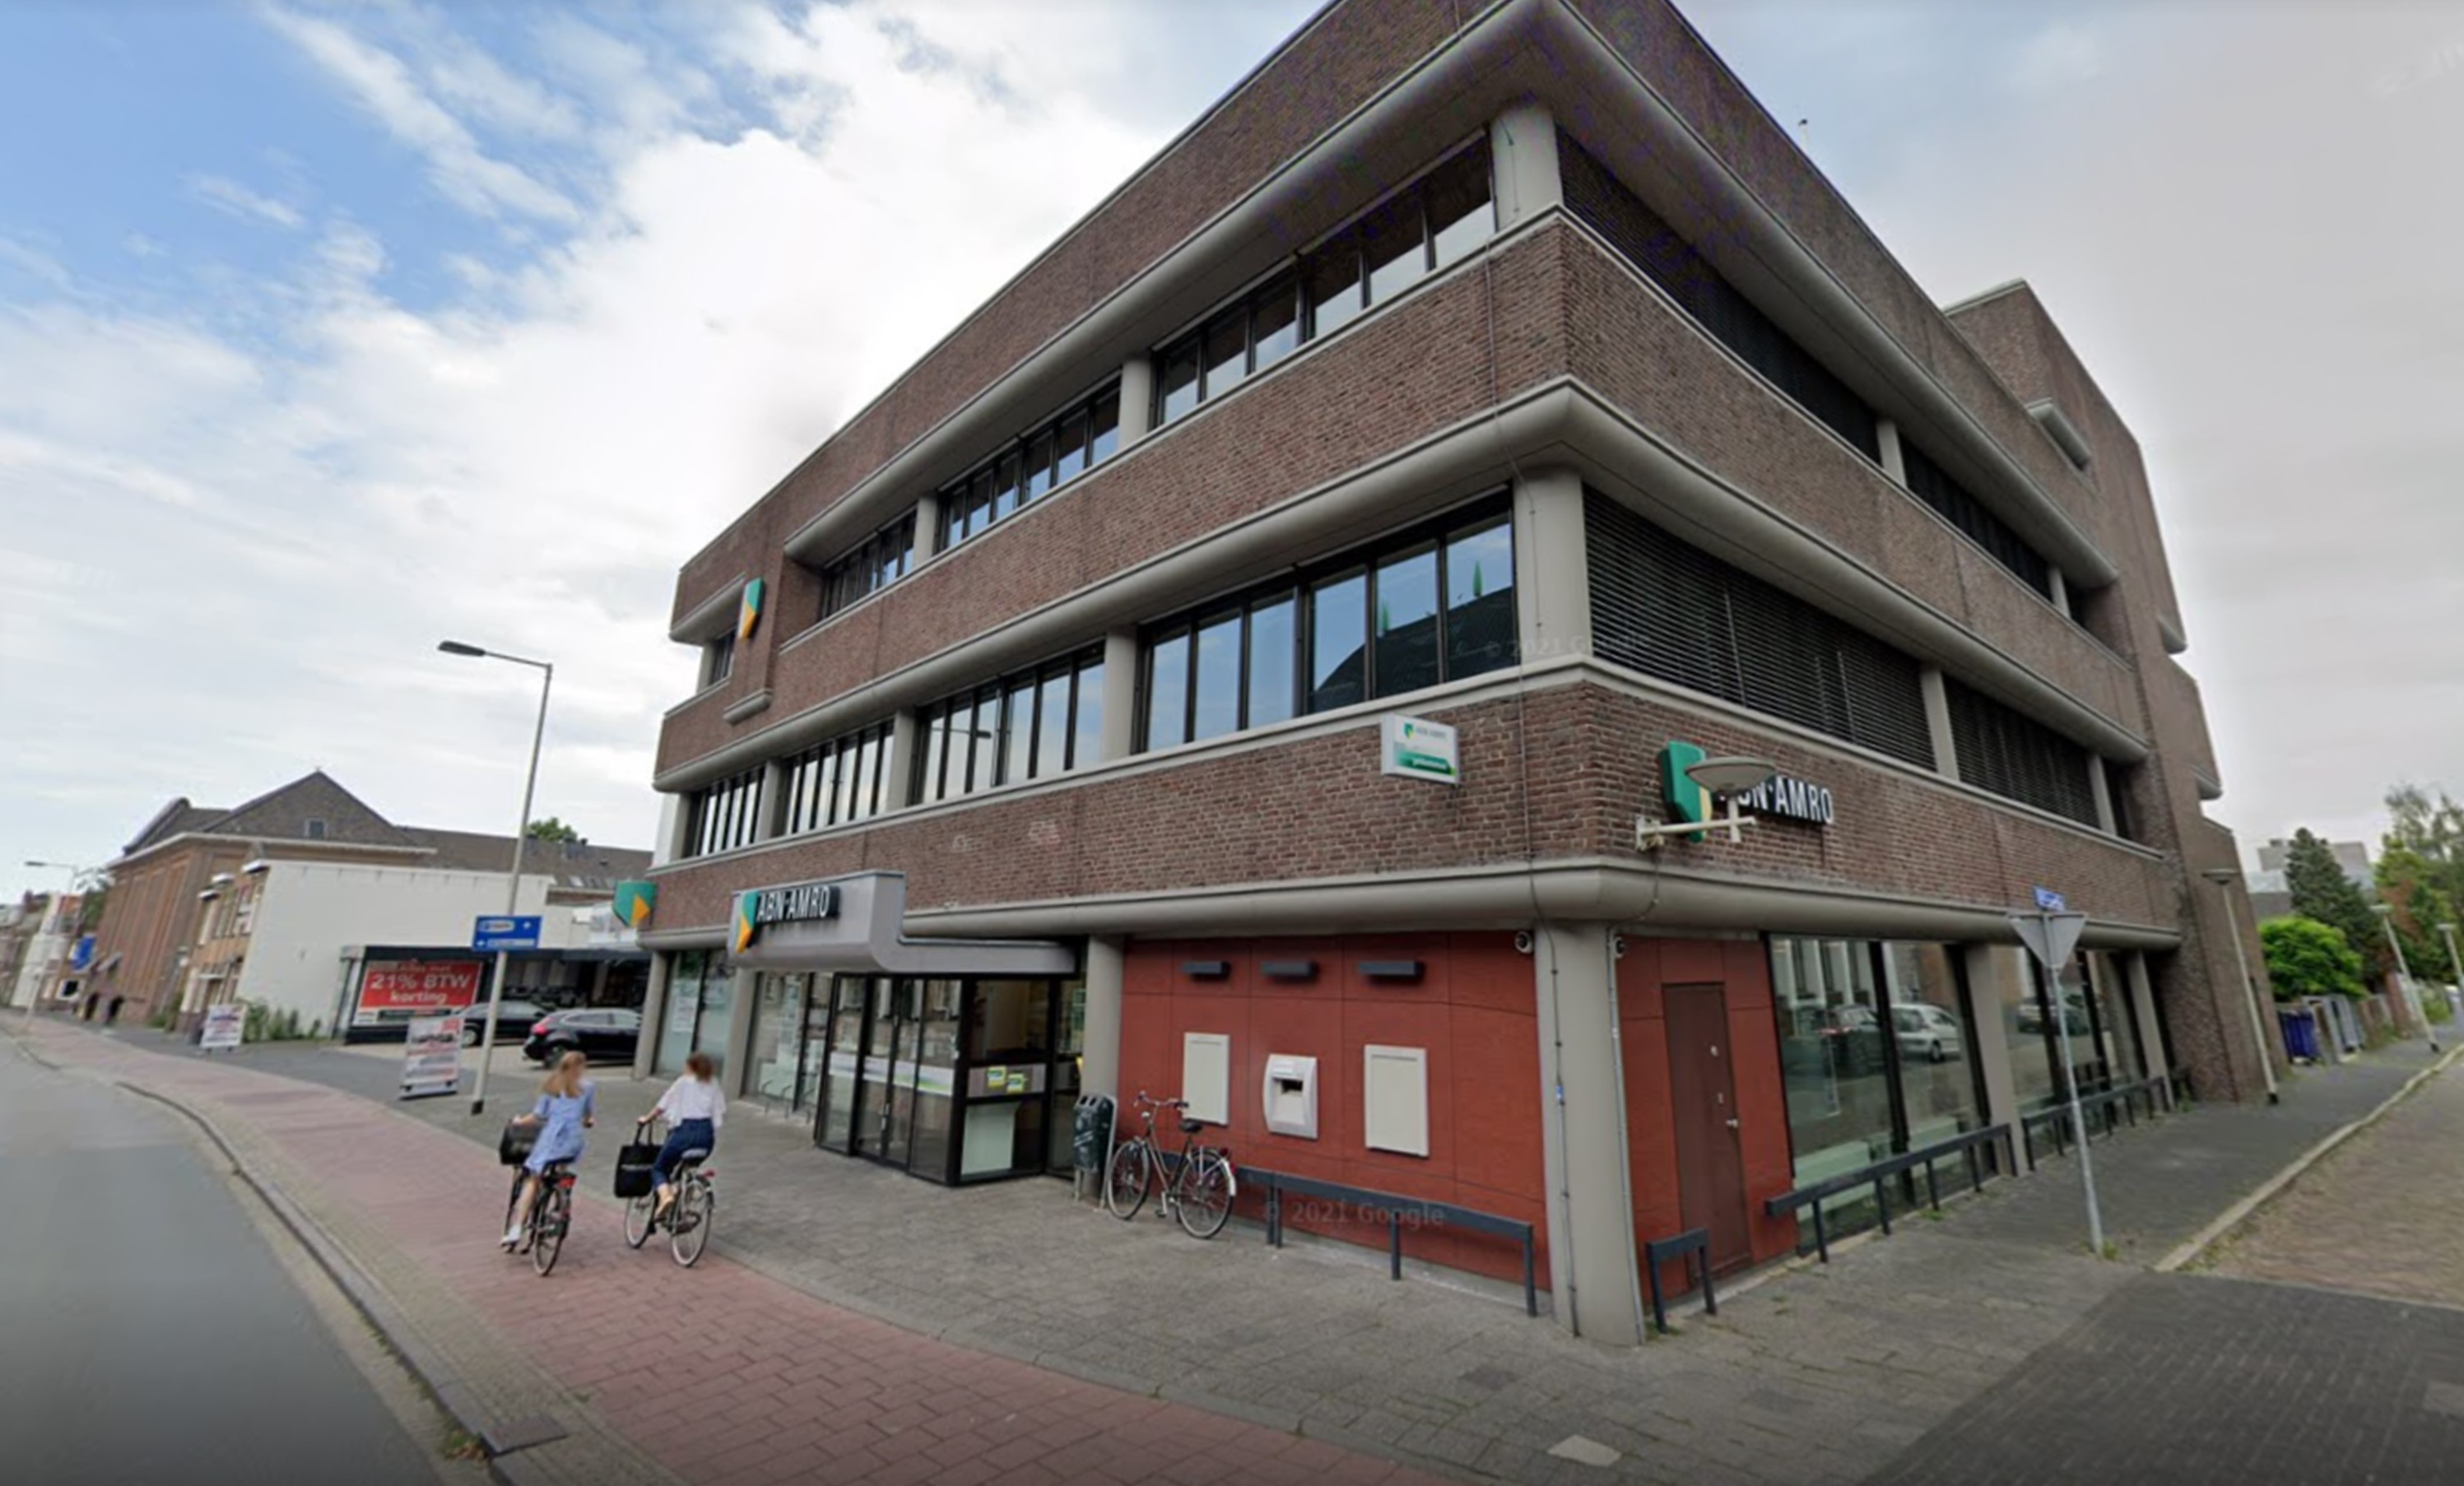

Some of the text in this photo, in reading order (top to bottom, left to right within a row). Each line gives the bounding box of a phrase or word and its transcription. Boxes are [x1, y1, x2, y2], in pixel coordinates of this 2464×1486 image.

[1775, 775, 1834, 824] AMRO
[370, 973, 472, 989] 21% BTW
[389, 990, 449, 1006] korting
